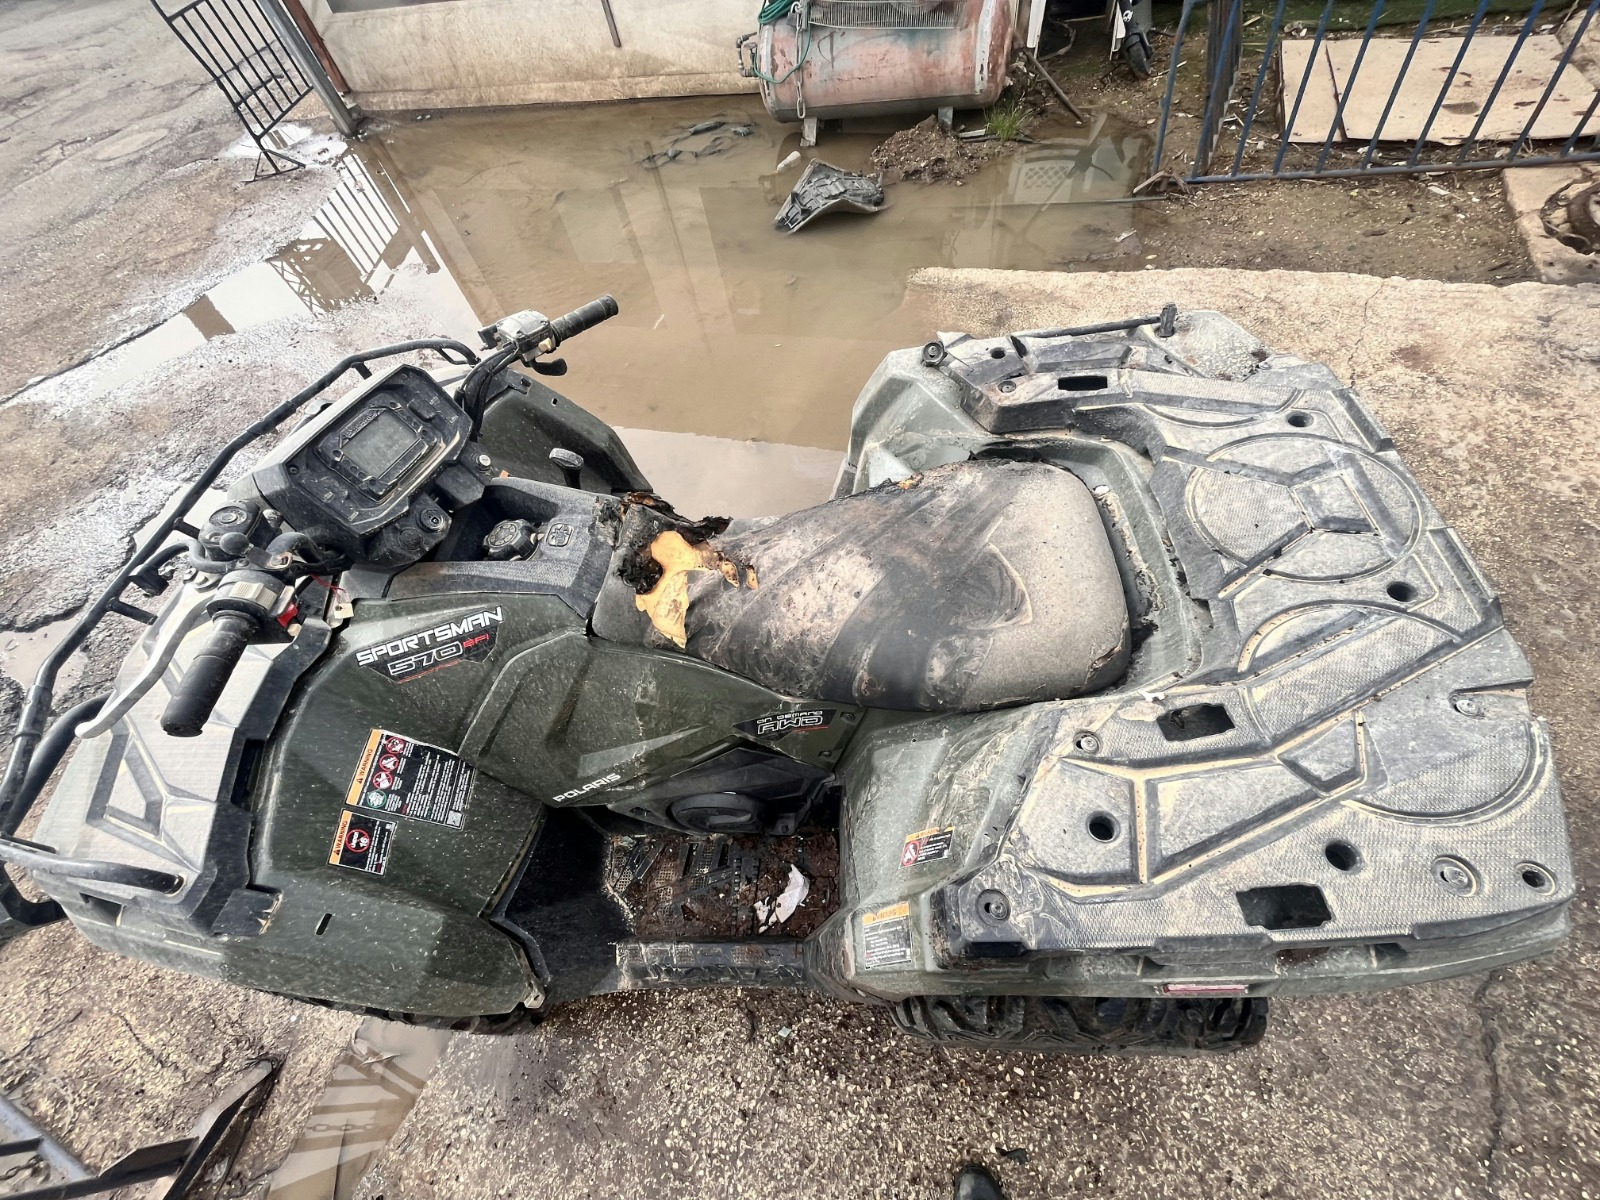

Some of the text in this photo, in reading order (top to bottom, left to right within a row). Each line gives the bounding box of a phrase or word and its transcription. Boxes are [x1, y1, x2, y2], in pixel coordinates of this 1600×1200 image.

[356, 606, 503, 667] SPORTSMAN
[388, 641, 463, 676] 570
[757, 715, 823, 735] AWD
[359, 748, 373, 777] WARNING
[552, 773, 621, 802] POLARIS
[336, 820, 348, 847] WARNING
[360, 837, 370, 848] 16
